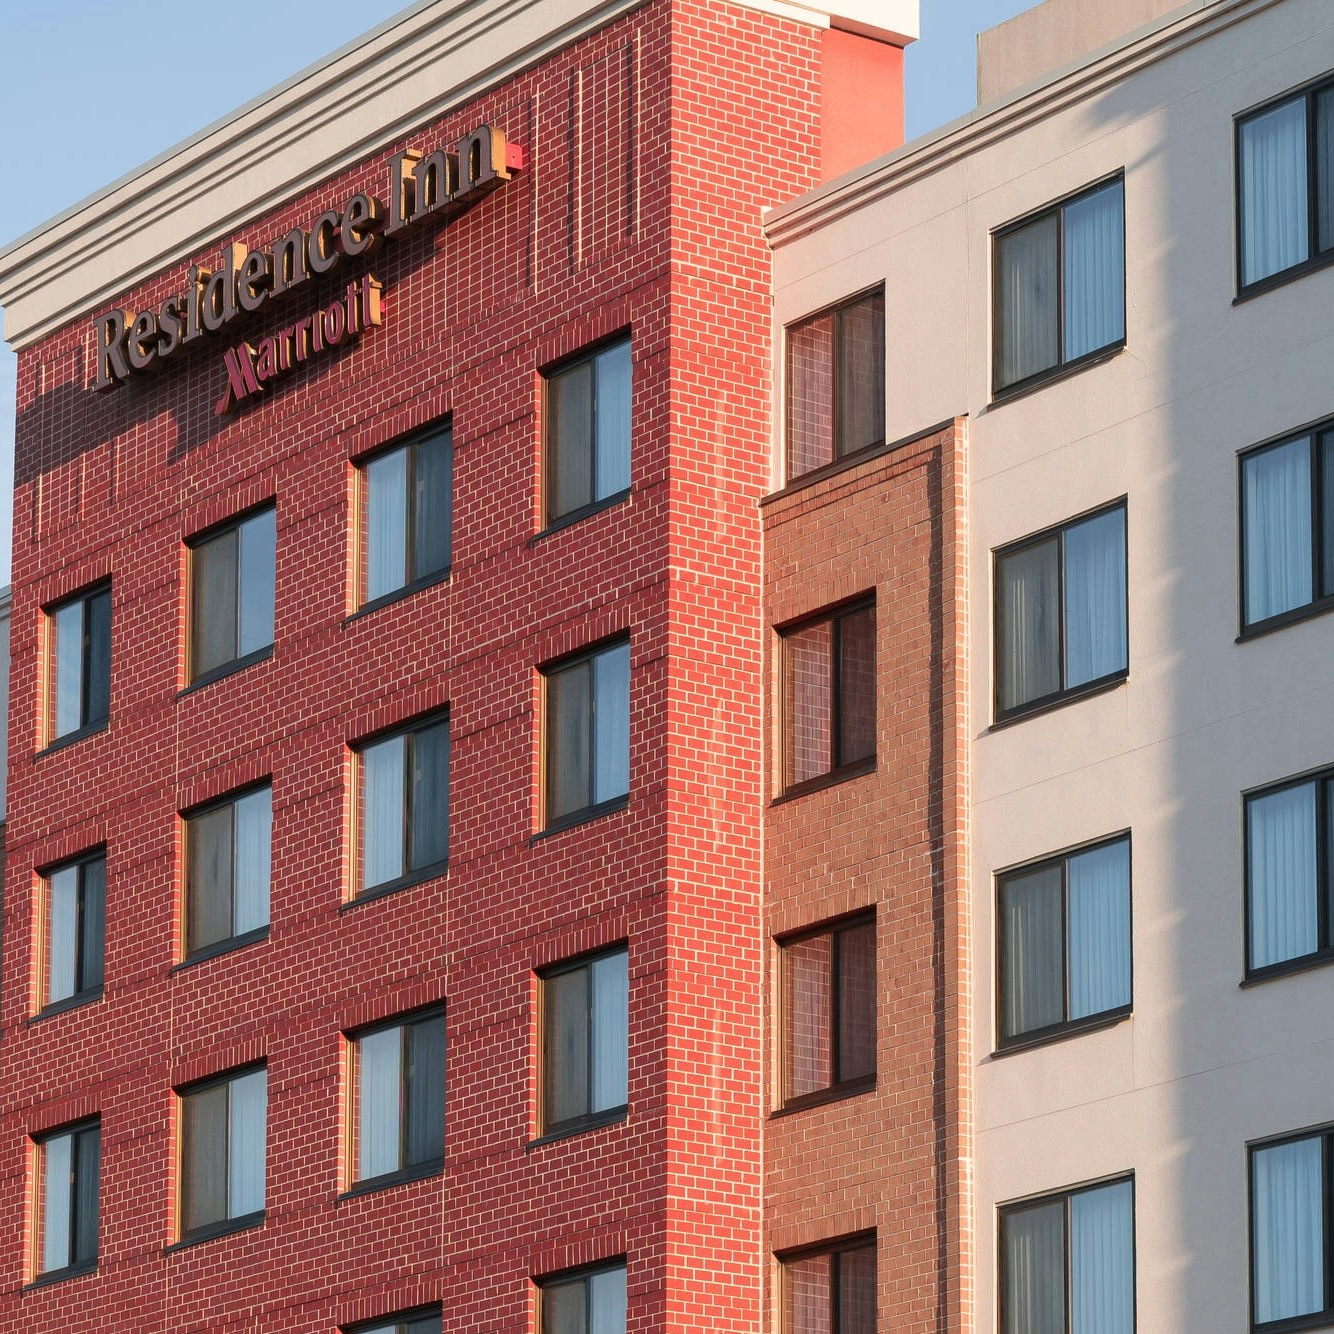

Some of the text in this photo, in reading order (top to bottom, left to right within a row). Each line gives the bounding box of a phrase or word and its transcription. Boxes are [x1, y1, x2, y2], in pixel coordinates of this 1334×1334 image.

[92, 124, 509, 393] Residence Inn
[214, 274, 382, 416] Marriott
